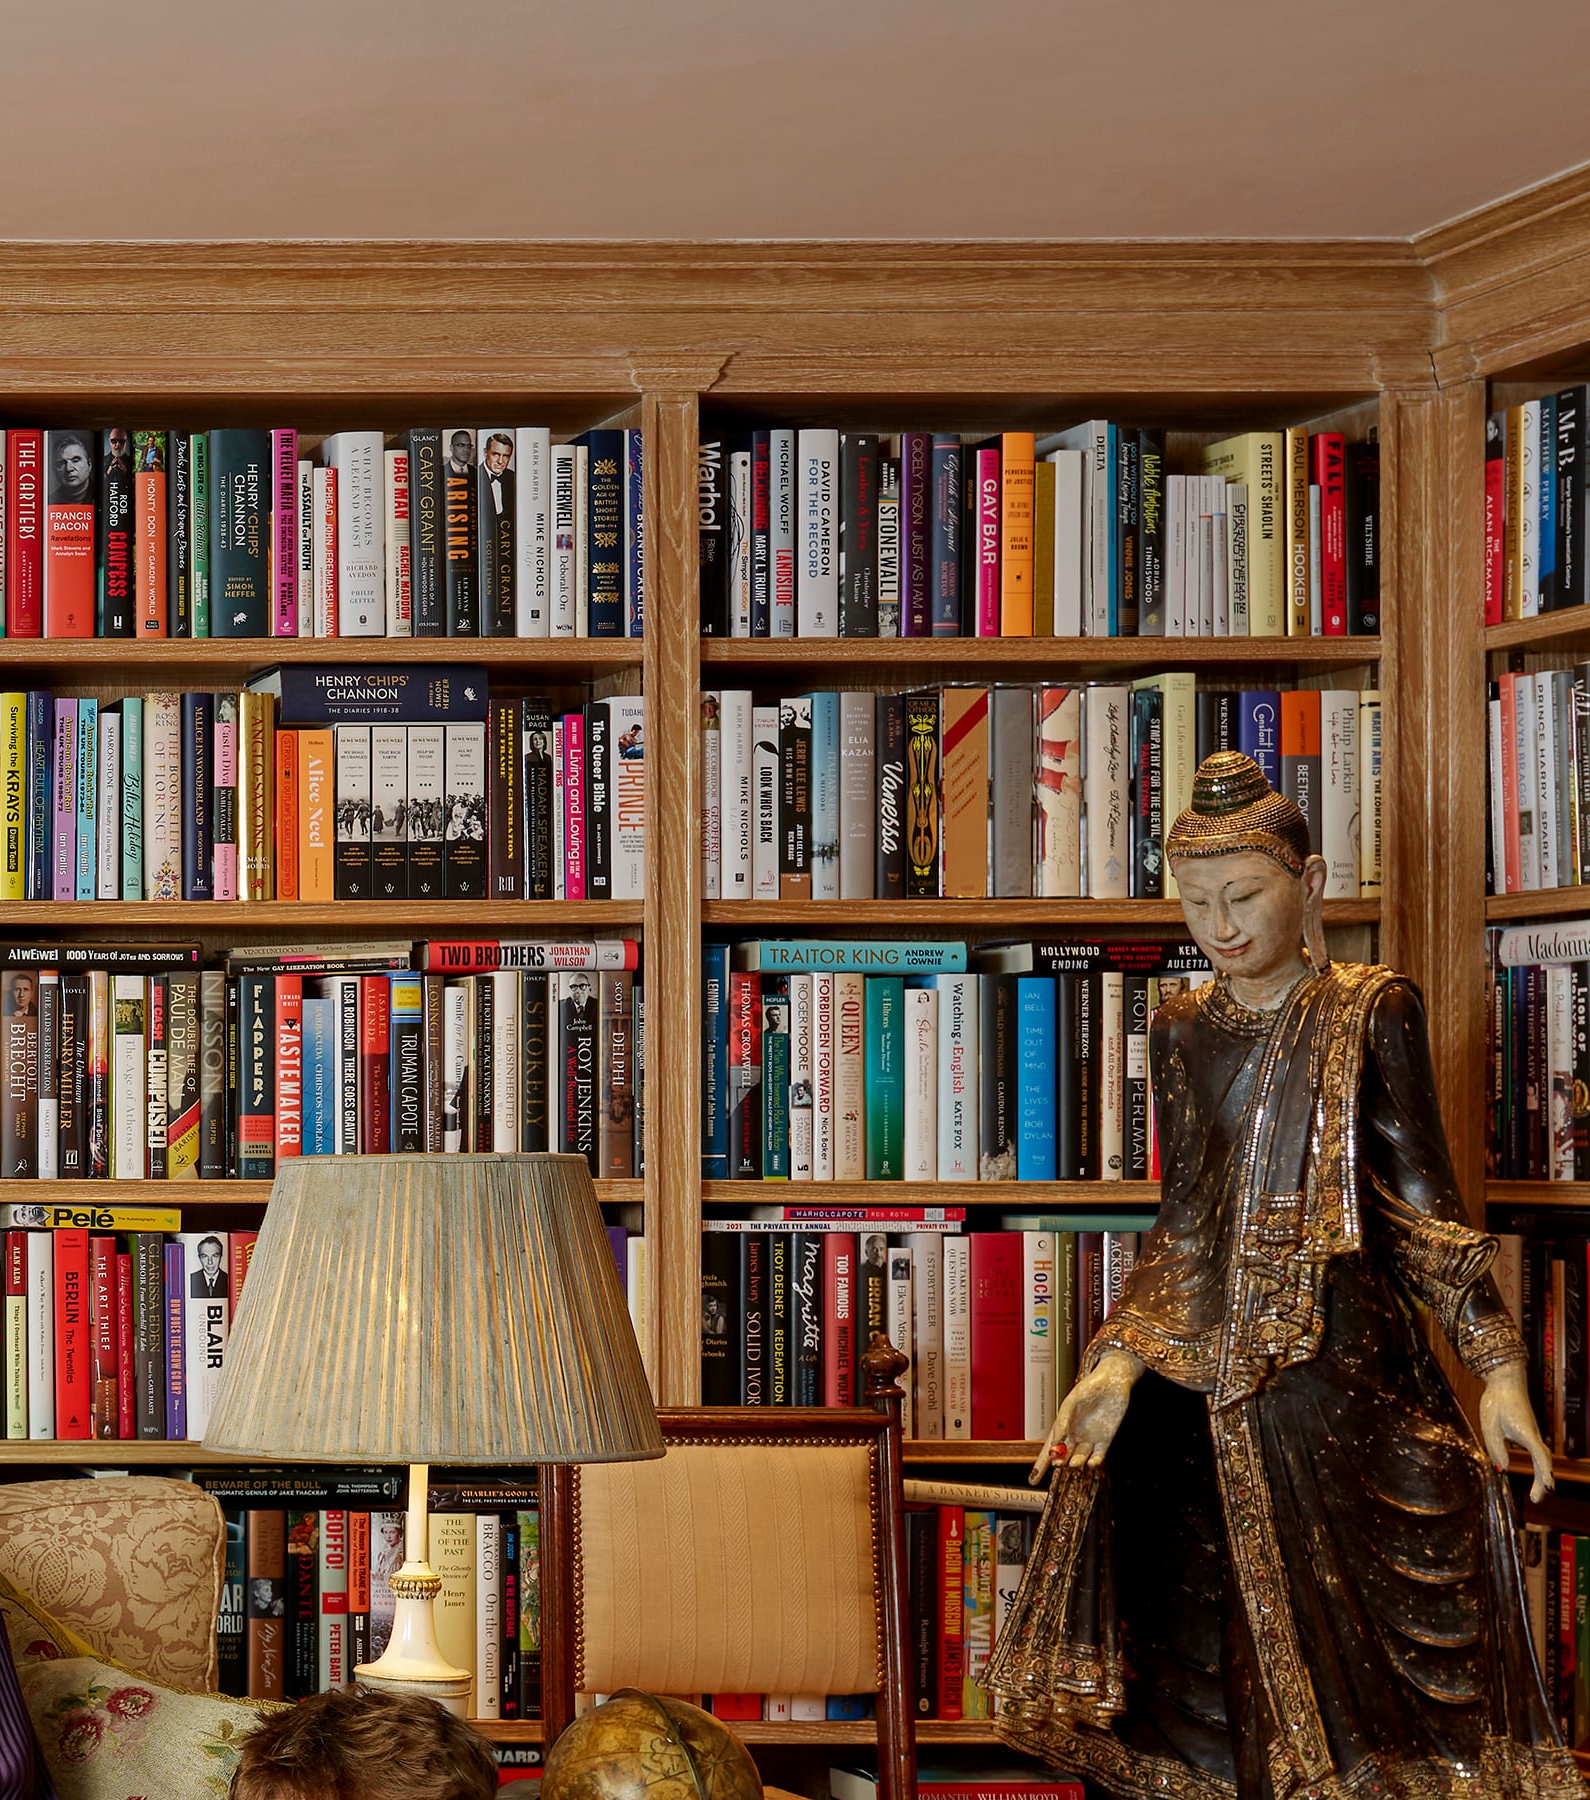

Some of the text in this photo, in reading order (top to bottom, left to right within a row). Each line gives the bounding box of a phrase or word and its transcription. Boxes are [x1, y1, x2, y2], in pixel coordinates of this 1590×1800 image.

[235, 476, 246, 546] CHANNON
[248, 463, 259, 507] HENRY
[557, 458, 571, 529] MOTHERWELL
[701, 442, 721, 532] Warhol
[50, 512, 92, 521] FRANCIS
[53, 522, 89, 531] BACON
[821, 460, 830, 576] DAVID CAMERON
[982, 480, 997, 565] GAY BAR
[880, 506, 898, 596] STONEWALL
[1294, 544, 1305, 607] HOOKED
[224, 590, 256, 598] HEFFER
[327, 689, 398, 700] CHANNON
[1537, 684, 1545, 740] PRINCE
[593, 720, 605, 813] The Queer Bible
[842, 749, 874, 757] KAZAN
[7, 770, 20, 822] KRAYS
[880, 761, 902, 854] Vanessa
[440, 944, 545, 967] TWO BROTHERS
[770, 948, 898, 964] TRAITOR KING
[904, 949, 943, 957] ANDREW
[907, 957, 943, 965] LOWNIE
[1041, 946, 1100, 957] HOLLYWOOD
[1052, 960, 1089, 970] ENDING
[253, 985, 263, 1106] FLAPPERS
[401, 1033, 418, 1135] TRUMAN CAPOTE
[578, 1038, 592, 1151] ROY JENKINS
[53, 1208, 114, 1230] Pelé
[66, 1272, 79, 1324] BERLIN
[774, 1241, 783, 1318] TROY DEENEY
[1030, 1261, 1052, 1337] Hockney
[207, 1305, 223, 1369] BLAIR
[326, 1510, 345, 1569] BOFFO!
[483, 1523, 493, 1581] BRACCO
